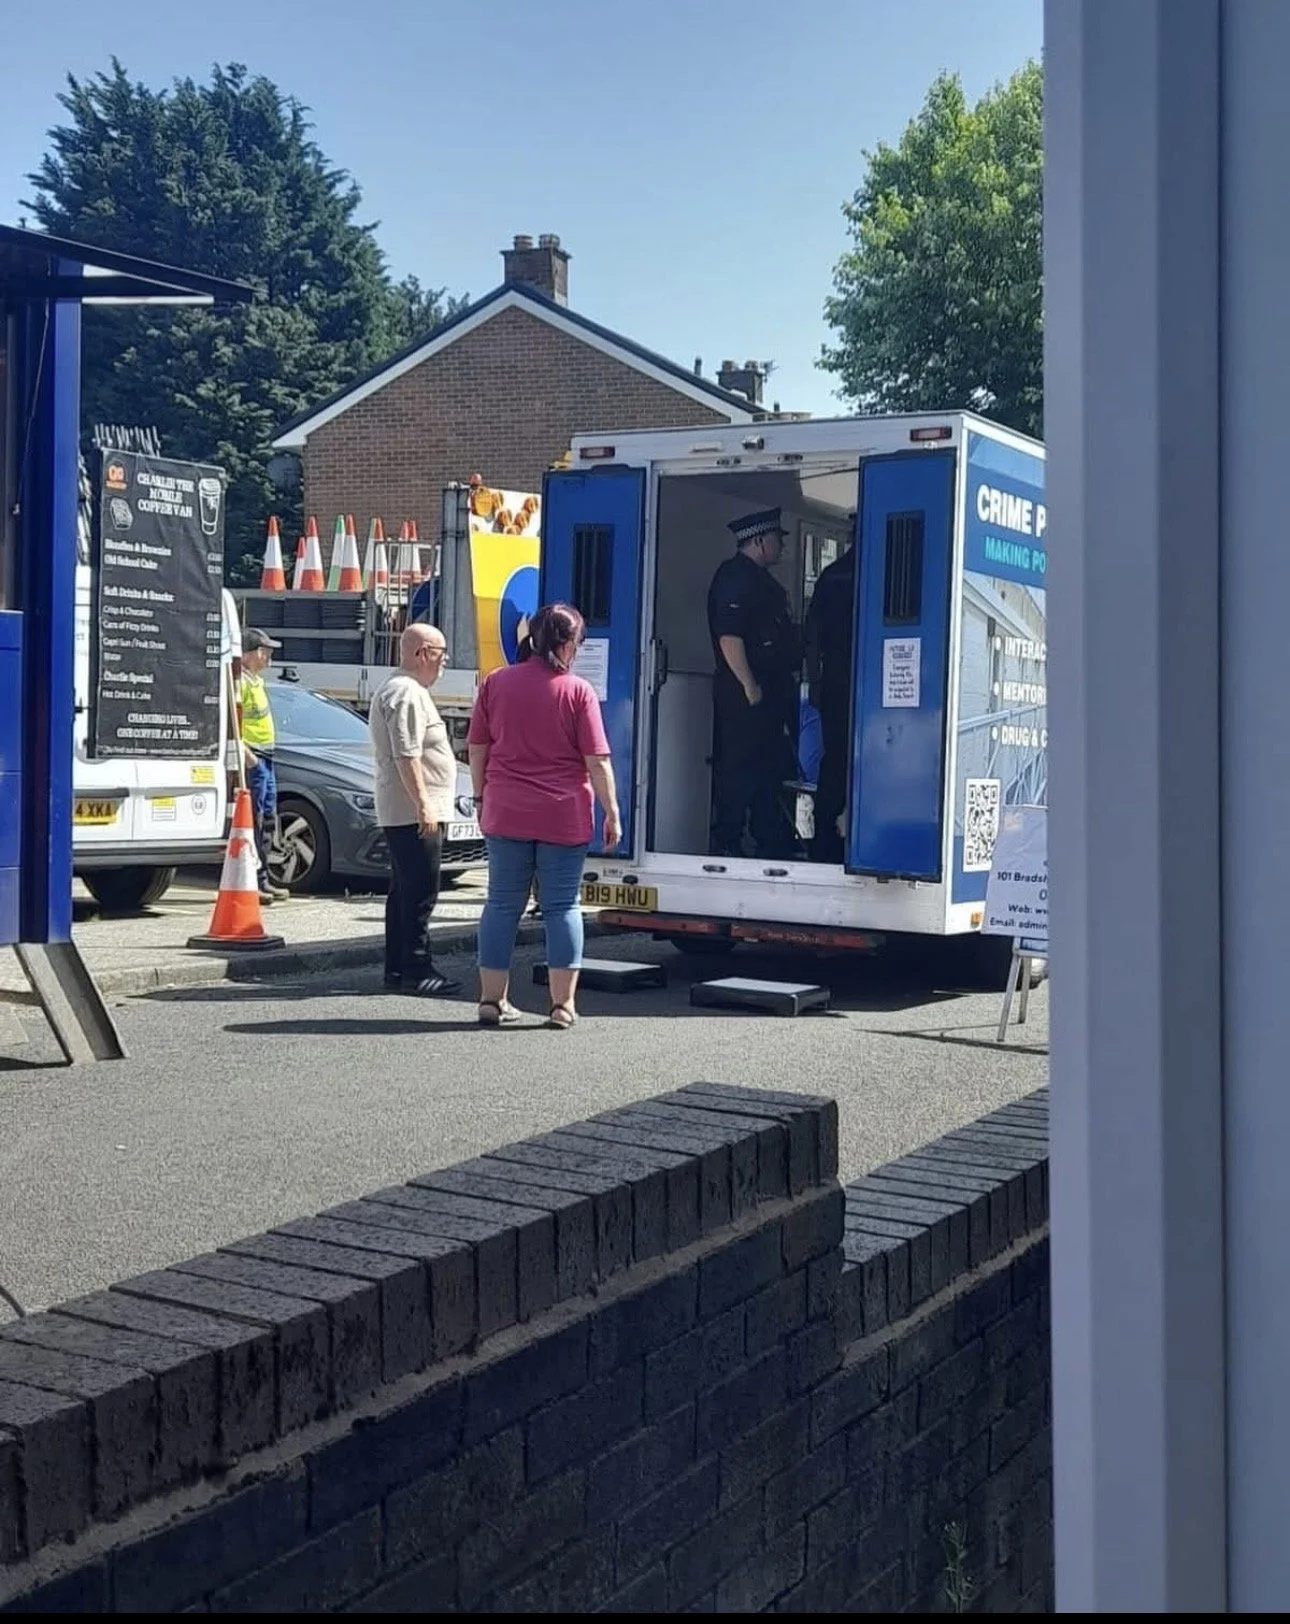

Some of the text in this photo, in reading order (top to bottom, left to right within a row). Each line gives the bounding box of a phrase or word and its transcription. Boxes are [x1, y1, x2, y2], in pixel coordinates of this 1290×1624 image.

[149, 487, 183, 504] MOBILE
[138, 498, 193, 518] COFFEE VAN
[977, 484, 1047, 538] CRIME P
[985, 536, 1030, 569] MAKING
[1005, 636, 1047, 661] INTERAC
[1001, 725, 1030, 747] DRUG
[1031, 729, 1038, 748] &
[997, 871, 1012, 881] 101
[585, 885, 648, 906] B19 HWU
[1008, 904, 1032, 914] Web:
[990, 917, 1016, 927] Email:
